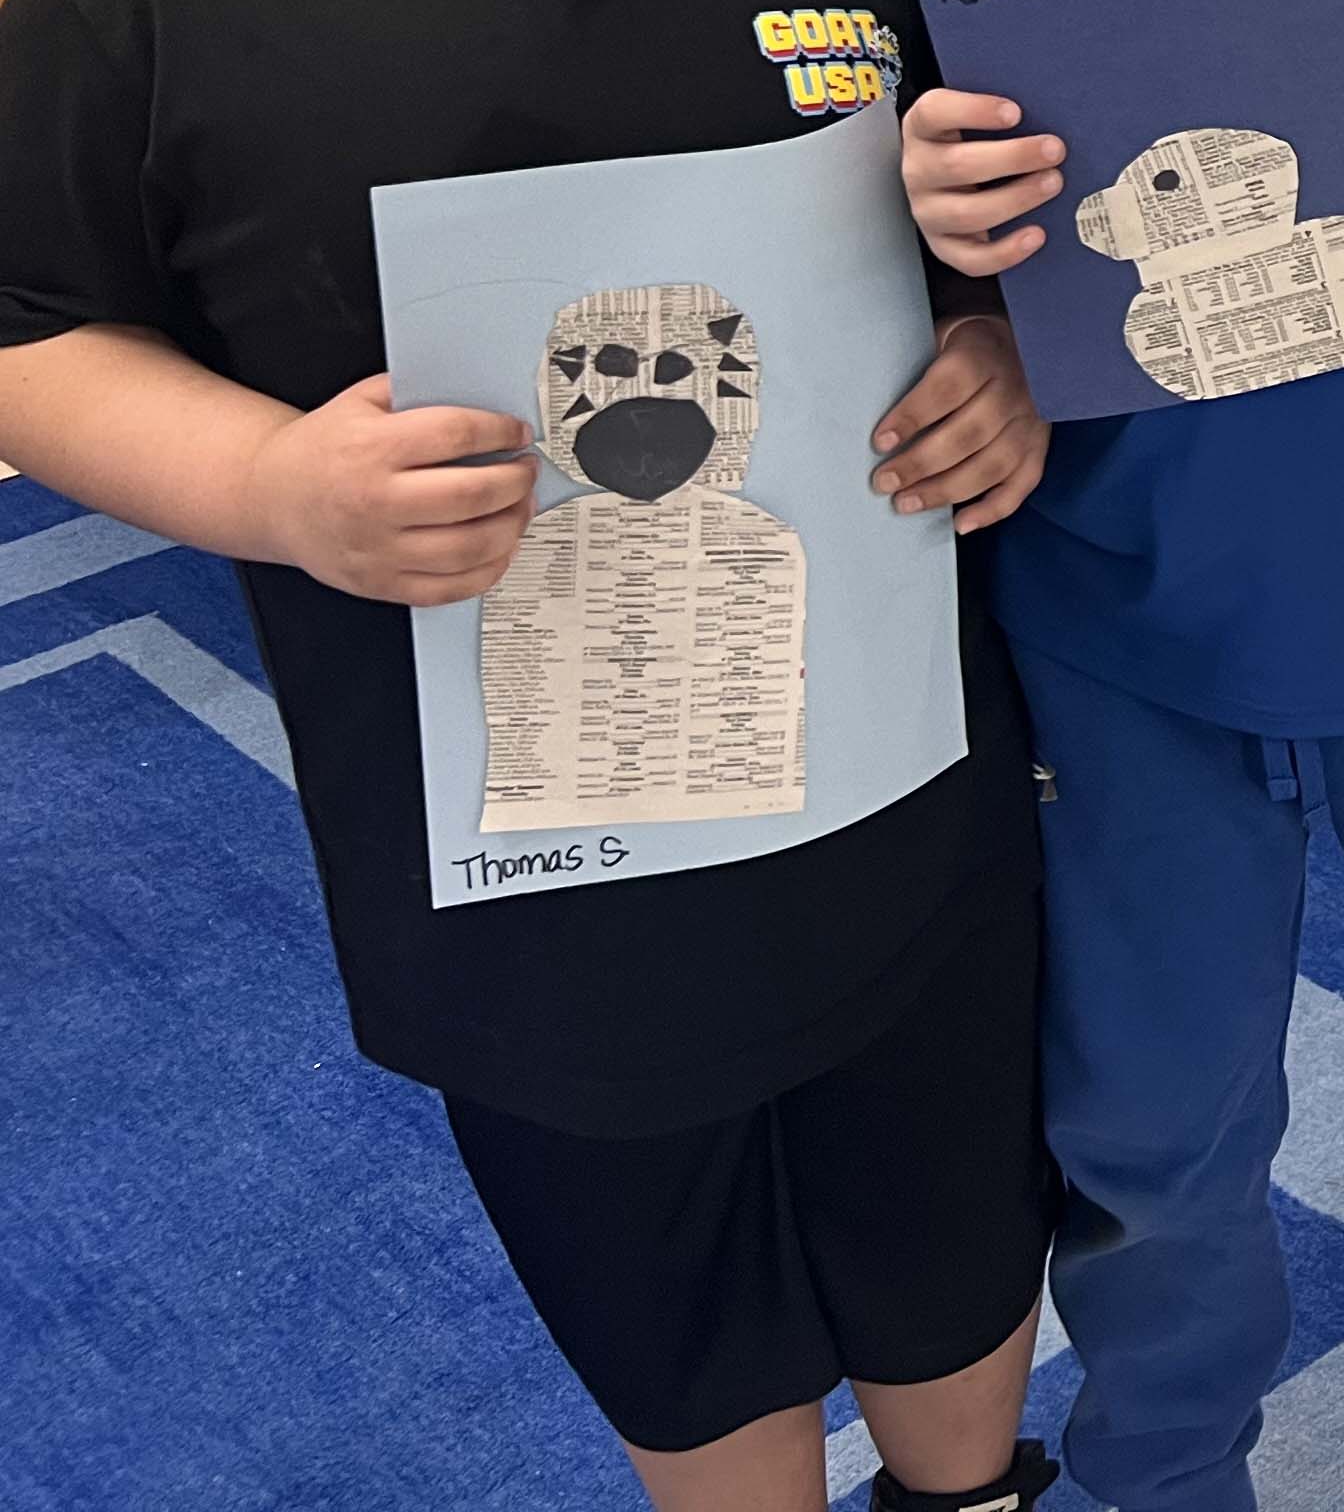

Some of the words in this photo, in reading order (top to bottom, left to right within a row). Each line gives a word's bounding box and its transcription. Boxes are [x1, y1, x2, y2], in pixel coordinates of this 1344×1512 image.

[753, 9, 880, 63] GOAT
[783, 61, 887, 117] USA
[451, 844, 584, 890] Thomas
[599, 835, 630, 868] S
